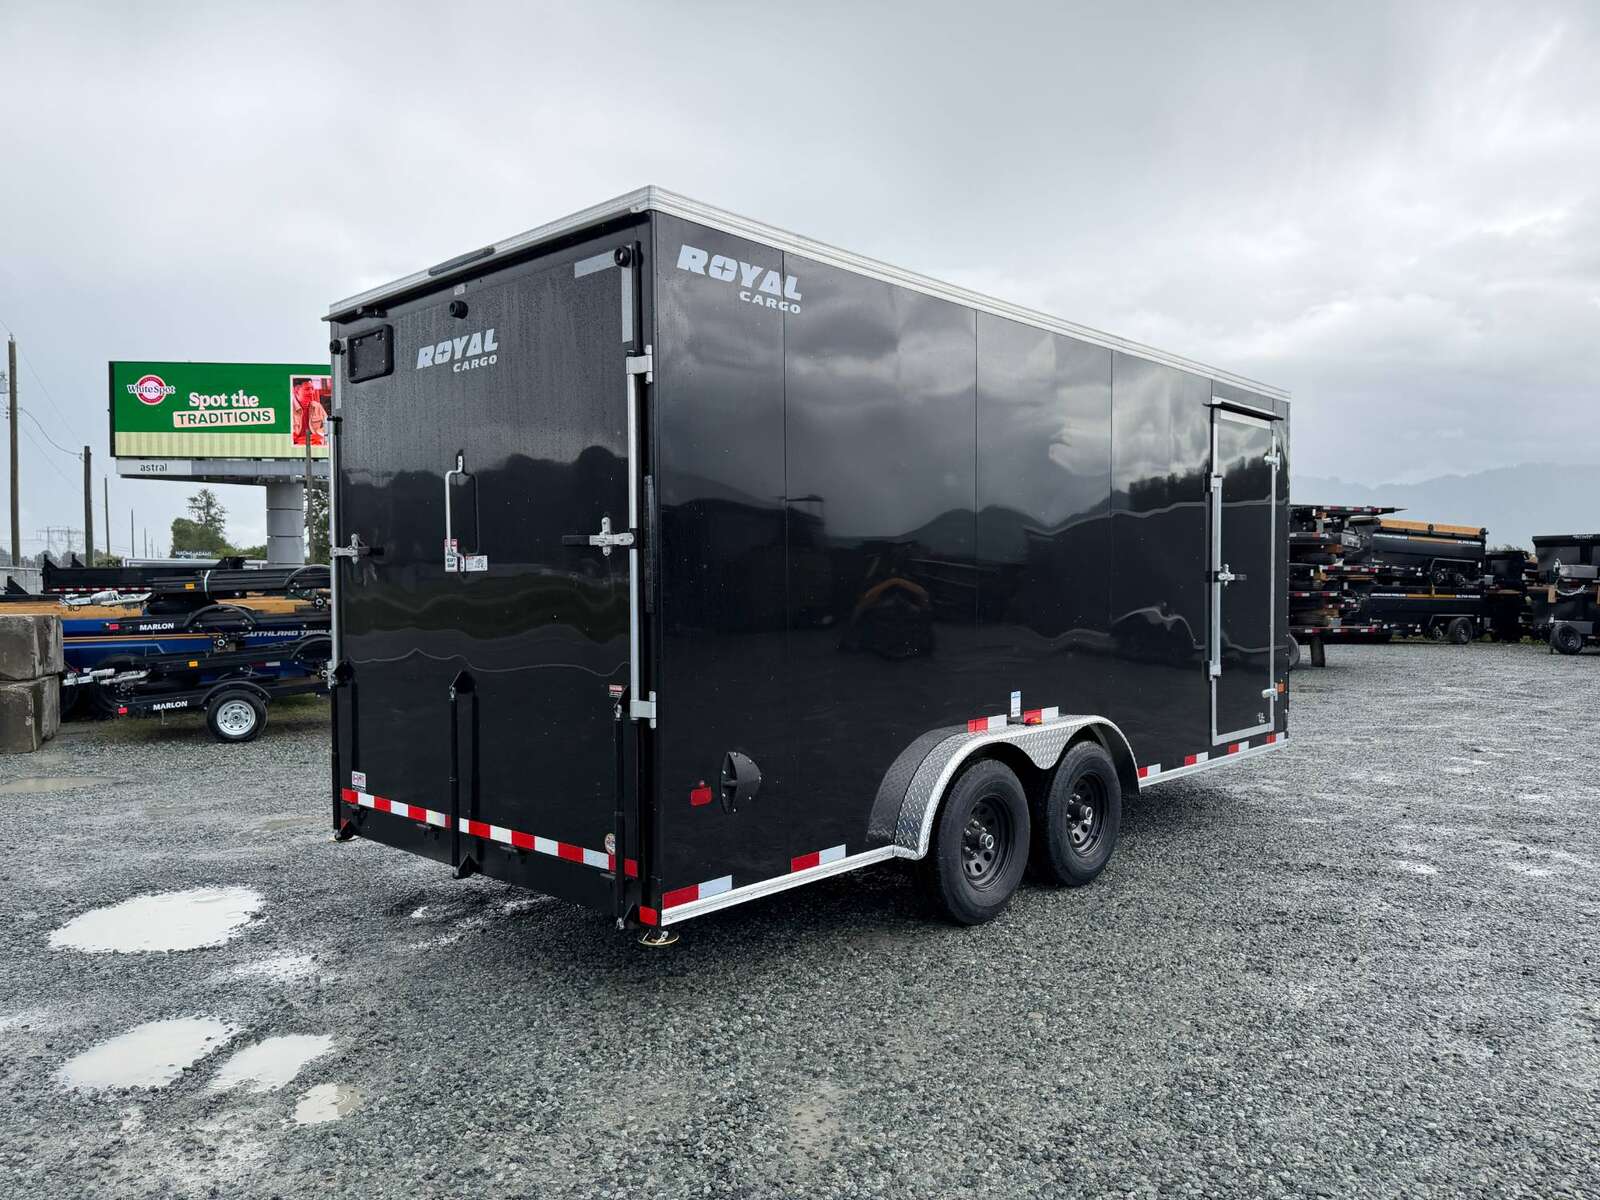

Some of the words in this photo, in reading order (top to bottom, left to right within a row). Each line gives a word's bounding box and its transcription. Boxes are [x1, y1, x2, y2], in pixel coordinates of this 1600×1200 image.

[676, 244, 802, 301] ROYAL
[739, 290, 801, 314] CARGO
[416, 328, 498, 370] ROYAL
[453, 354, 498, 373] CARGO
[189, 391, 228, 411] Spot
[231, 389, 260, 408] the
[177, 410, 271, 425] TRADITIONS
[140, 463, 168, 472] astral
[139, 622, 175, 632] MARLON
[152, 701, 188, 711] MARLON
